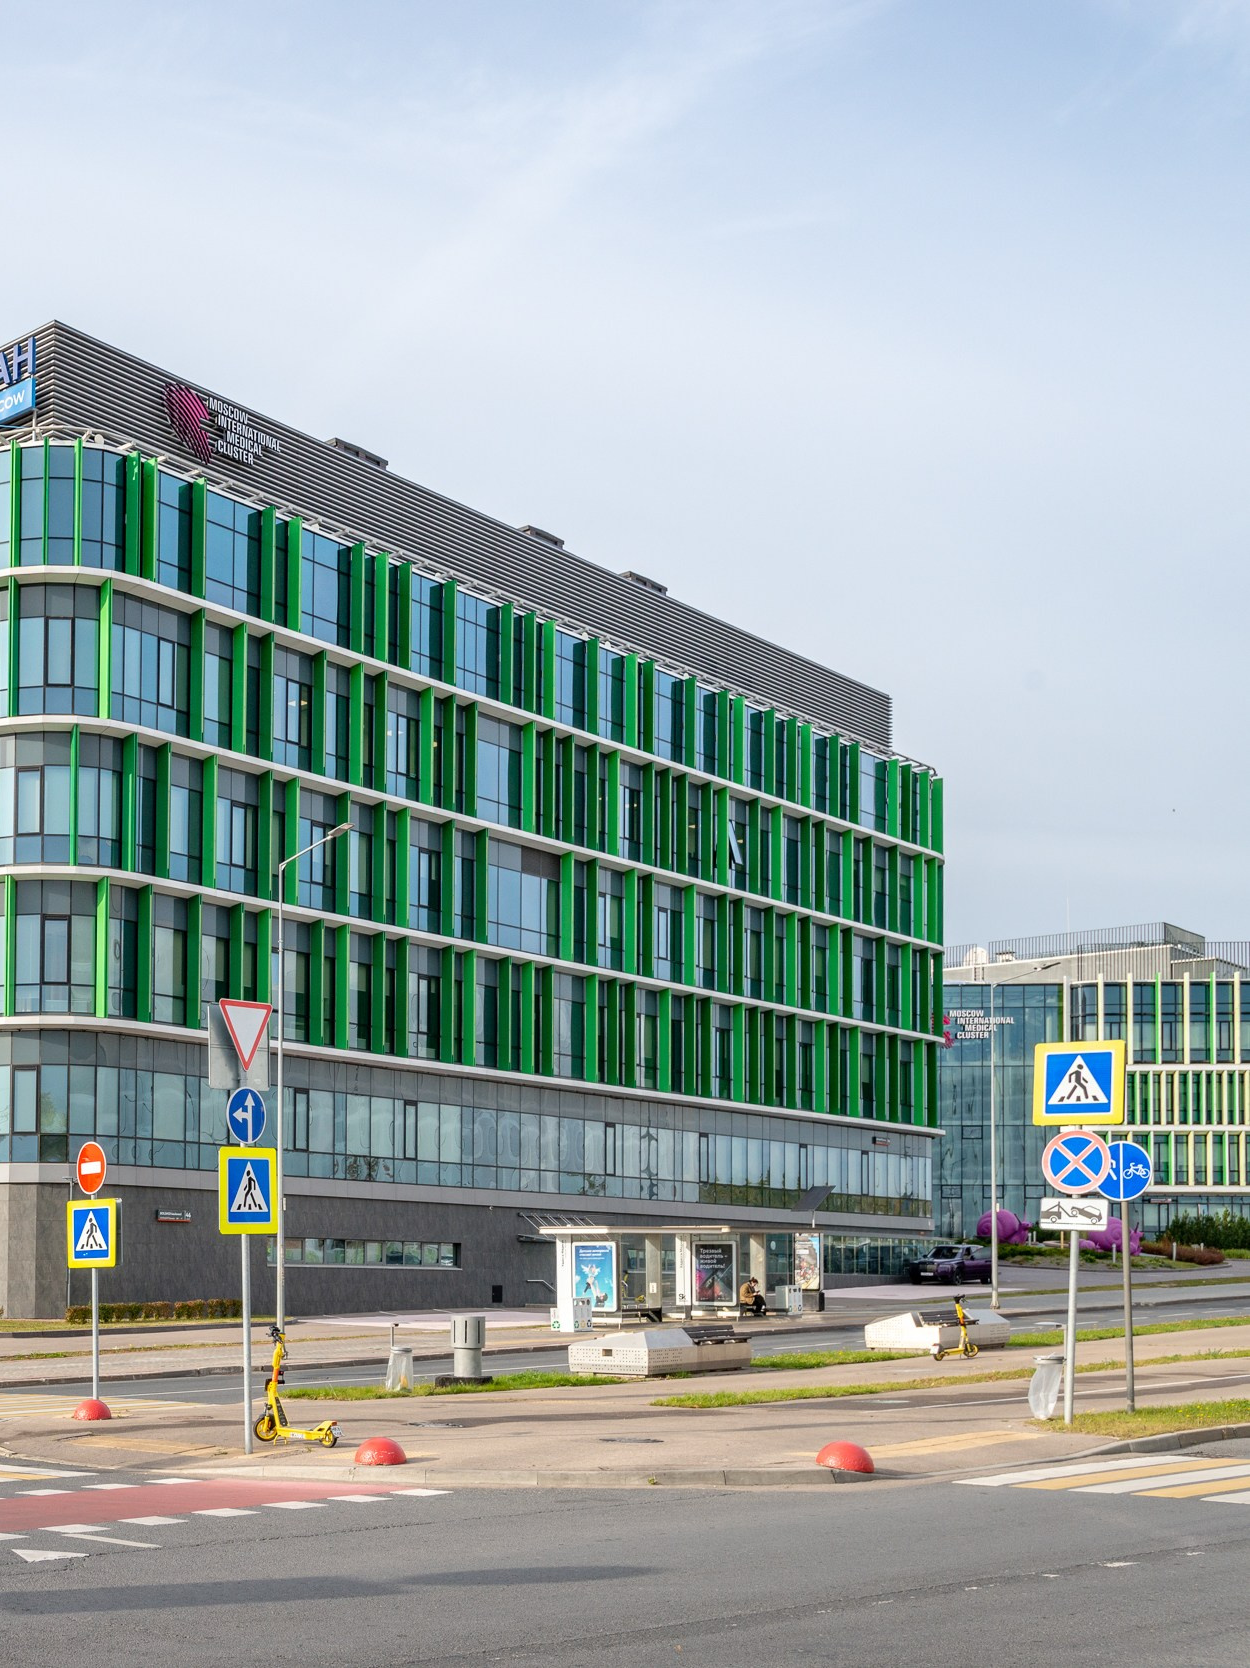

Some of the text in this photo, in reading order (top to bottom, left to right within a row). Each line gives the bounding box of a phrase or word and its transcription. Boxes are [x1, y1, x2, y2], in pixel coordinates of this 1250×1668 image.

[209, 397, 249, 424] MOSCOW
[217, 414, 281, 453] INTERNATIONAL
[226, 430, 263, 457] MEDICAL
[217, 440, 254, 465] CLUSTER
[957, 1031, 989, 1039] CLUSTER
